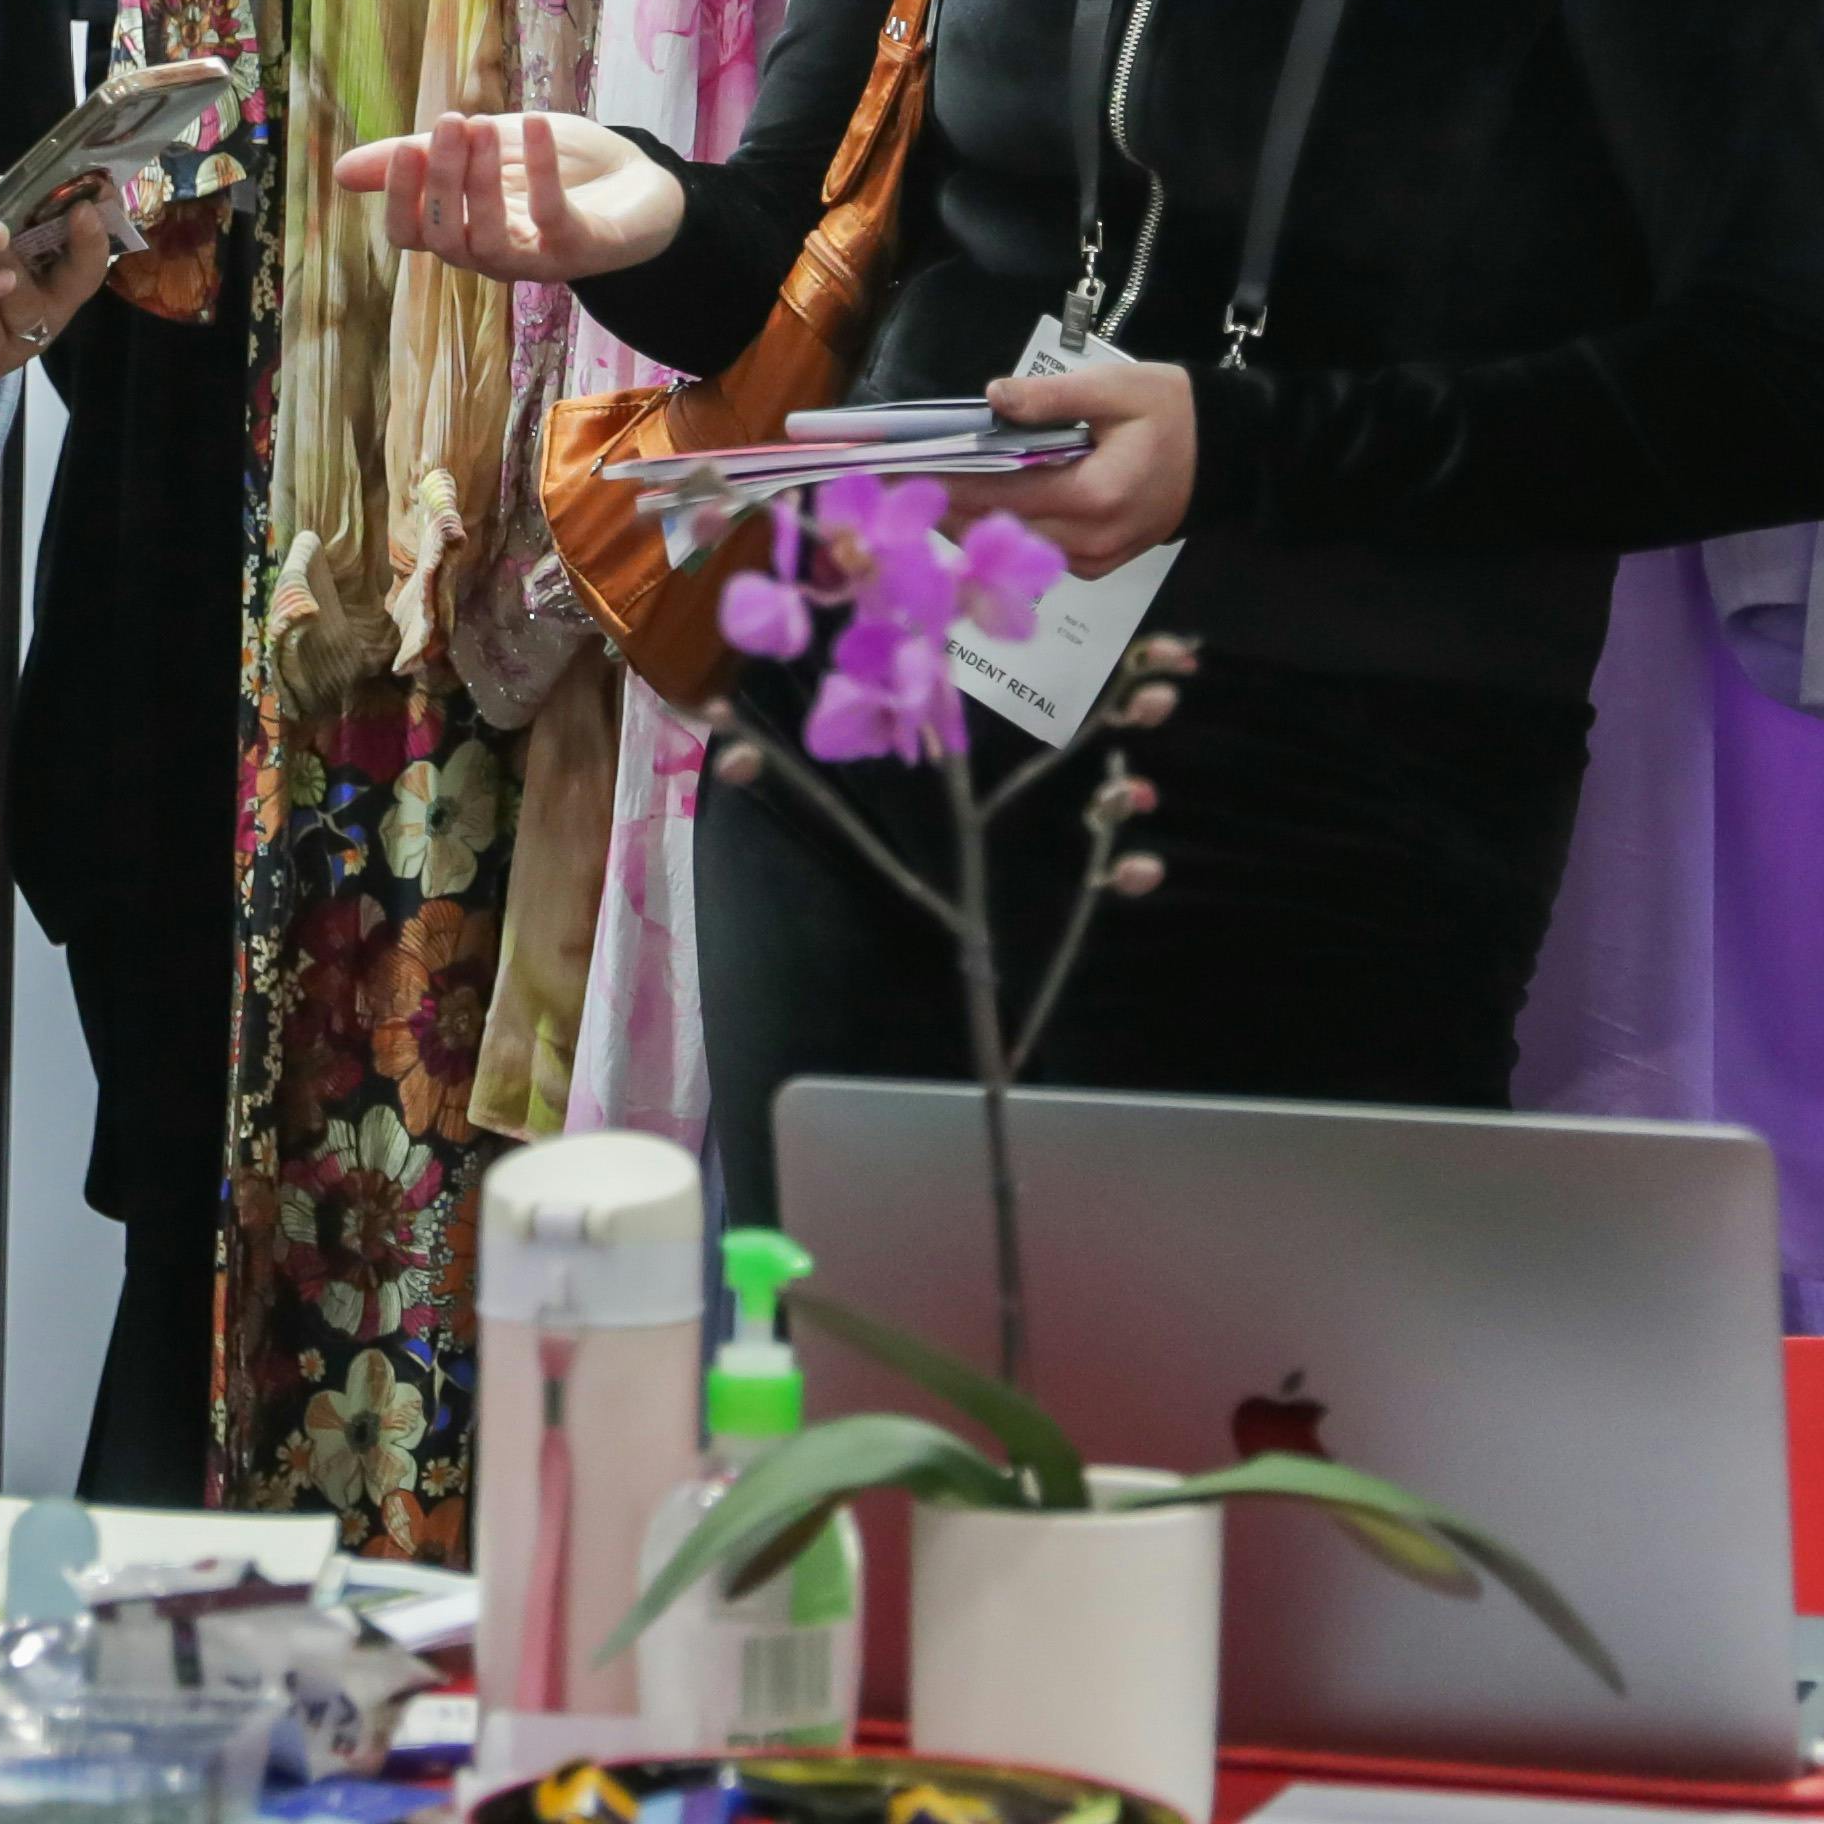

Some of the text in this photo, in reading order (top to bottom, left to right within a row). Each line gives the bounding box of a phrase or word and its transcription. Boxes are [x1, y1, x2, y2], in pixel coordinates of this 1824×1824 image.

[1036, 350, 1069, 374] INTERN
[944, 639, 1056, 719] ENDENT RETAIL
